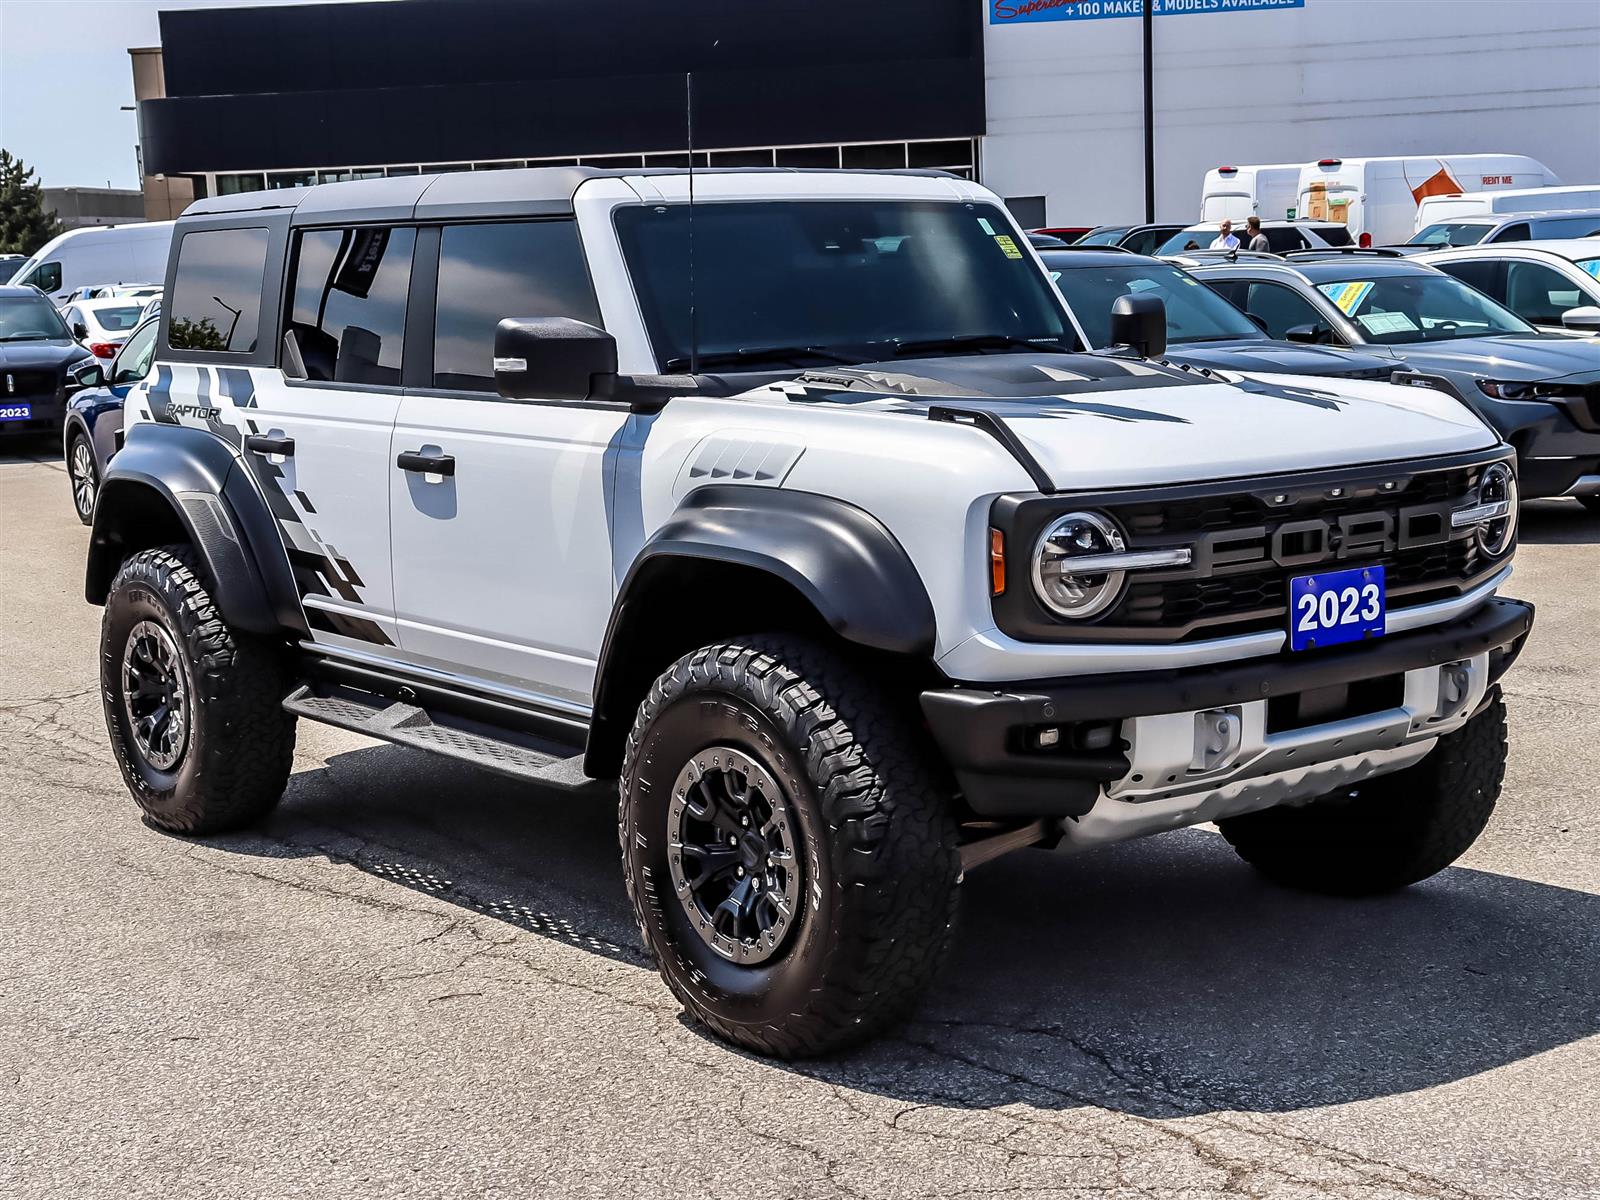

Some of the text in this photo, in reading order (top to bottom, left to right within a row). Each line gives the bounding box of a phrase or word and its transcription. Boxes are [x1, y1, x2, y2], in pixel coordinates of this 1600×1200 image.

[1077, 3, 1100, 15] 100
[1165, 0, 1217, 11] MODELS
[1482, 175, 1513, 185] RENT ME
[0, 407, 29, 418] 2023
[165, 403, 222, 428] RAPTOR
[1198, 501, 1451, 577] FORD
[1298, 583, 1381, 632] 2023
